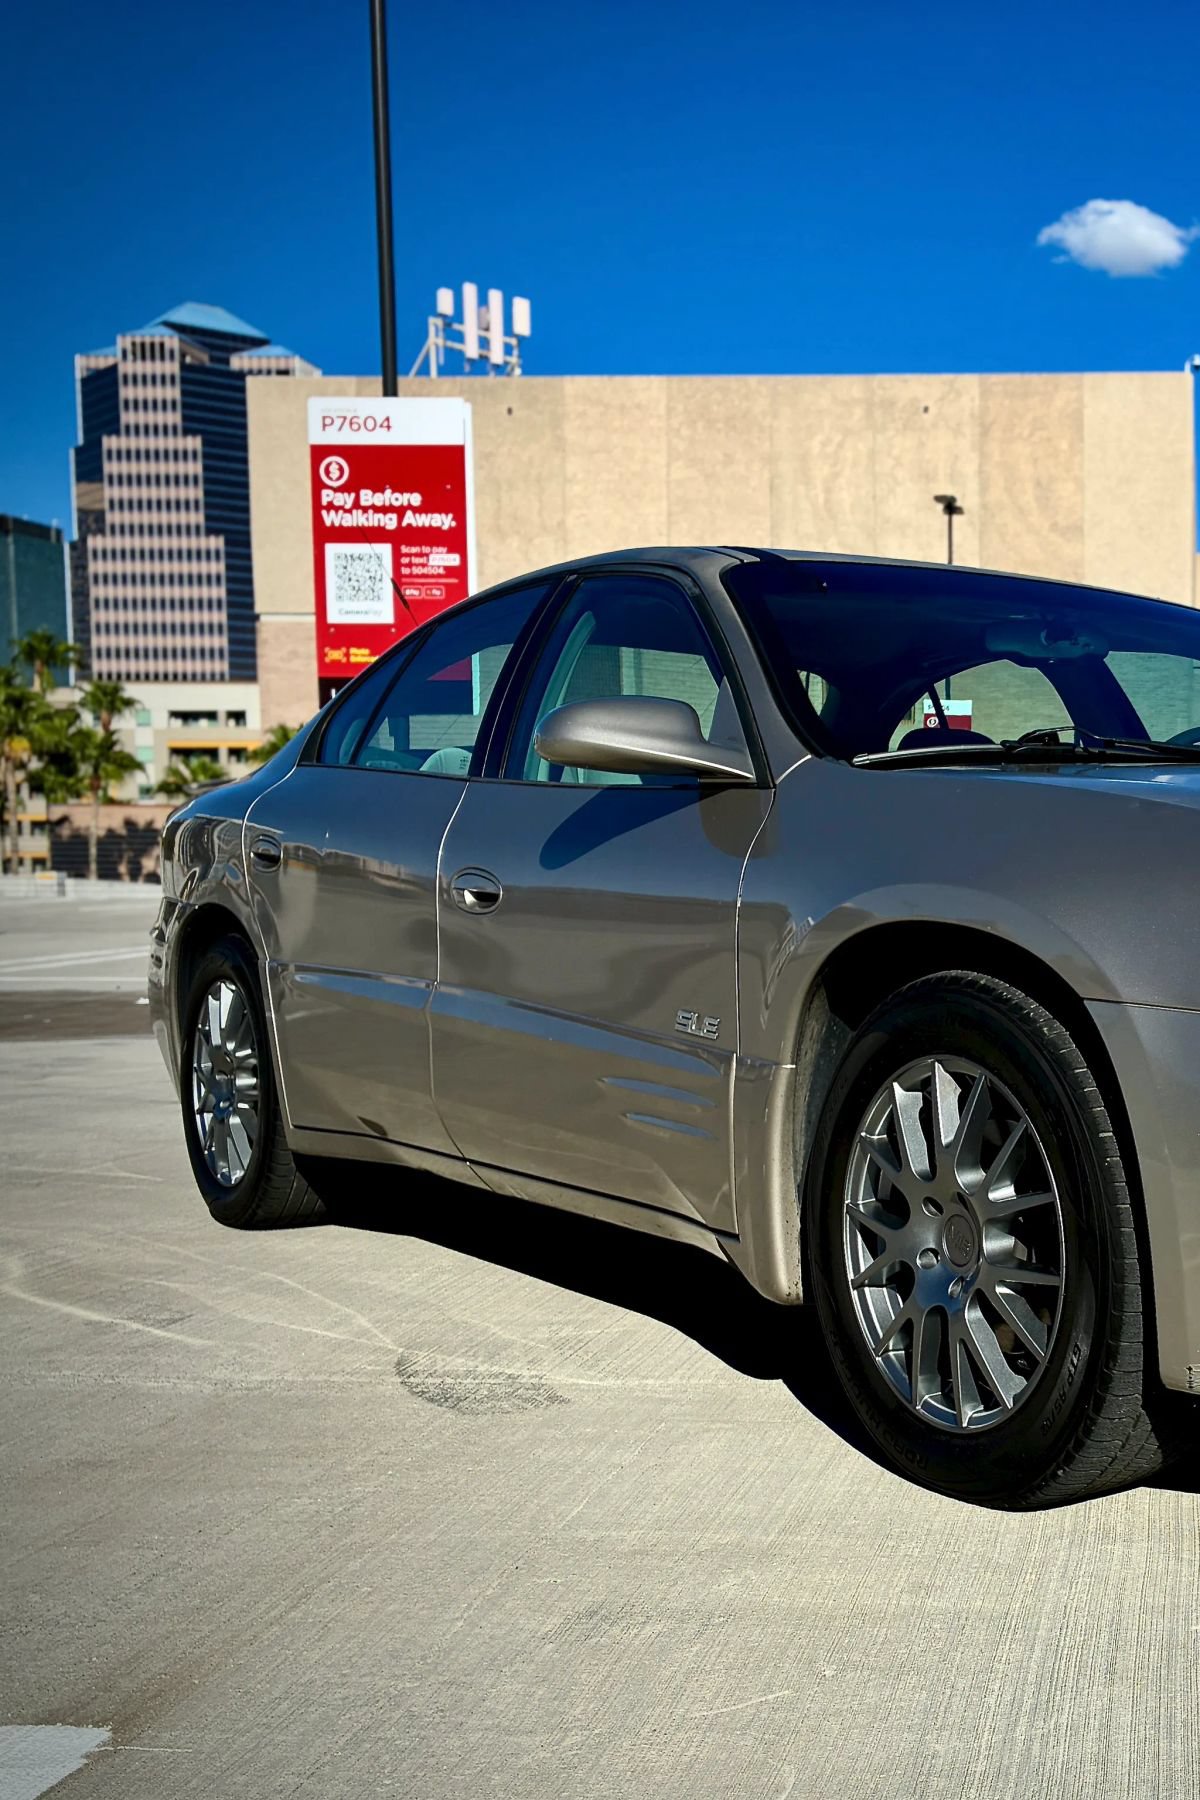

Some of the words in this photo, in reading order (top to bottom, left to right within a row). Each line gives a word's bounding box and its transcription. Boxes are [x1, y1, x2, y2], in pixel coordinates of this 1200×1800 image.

[321, 415, 392, 432] P7604
[321, 488, 355, 508] Pay
[359, 488, 423, 507] Before
[321, 509, 398, 530] Walking
[402, 510, 457, 530] Away.
[401, 545, 420, 554] Scan
[421, 545, 431, 554] to
[432, 546, 447, 554] pay
[401, 556, 410, 564] or
[411, 556, 427, 564] text
[401, 566, 411, 575] to
[411, 566, 446, 575] 504504.
[674, 1009, 720, 1040] SLE
[1066, 1341, 1082, 1387] GTP
